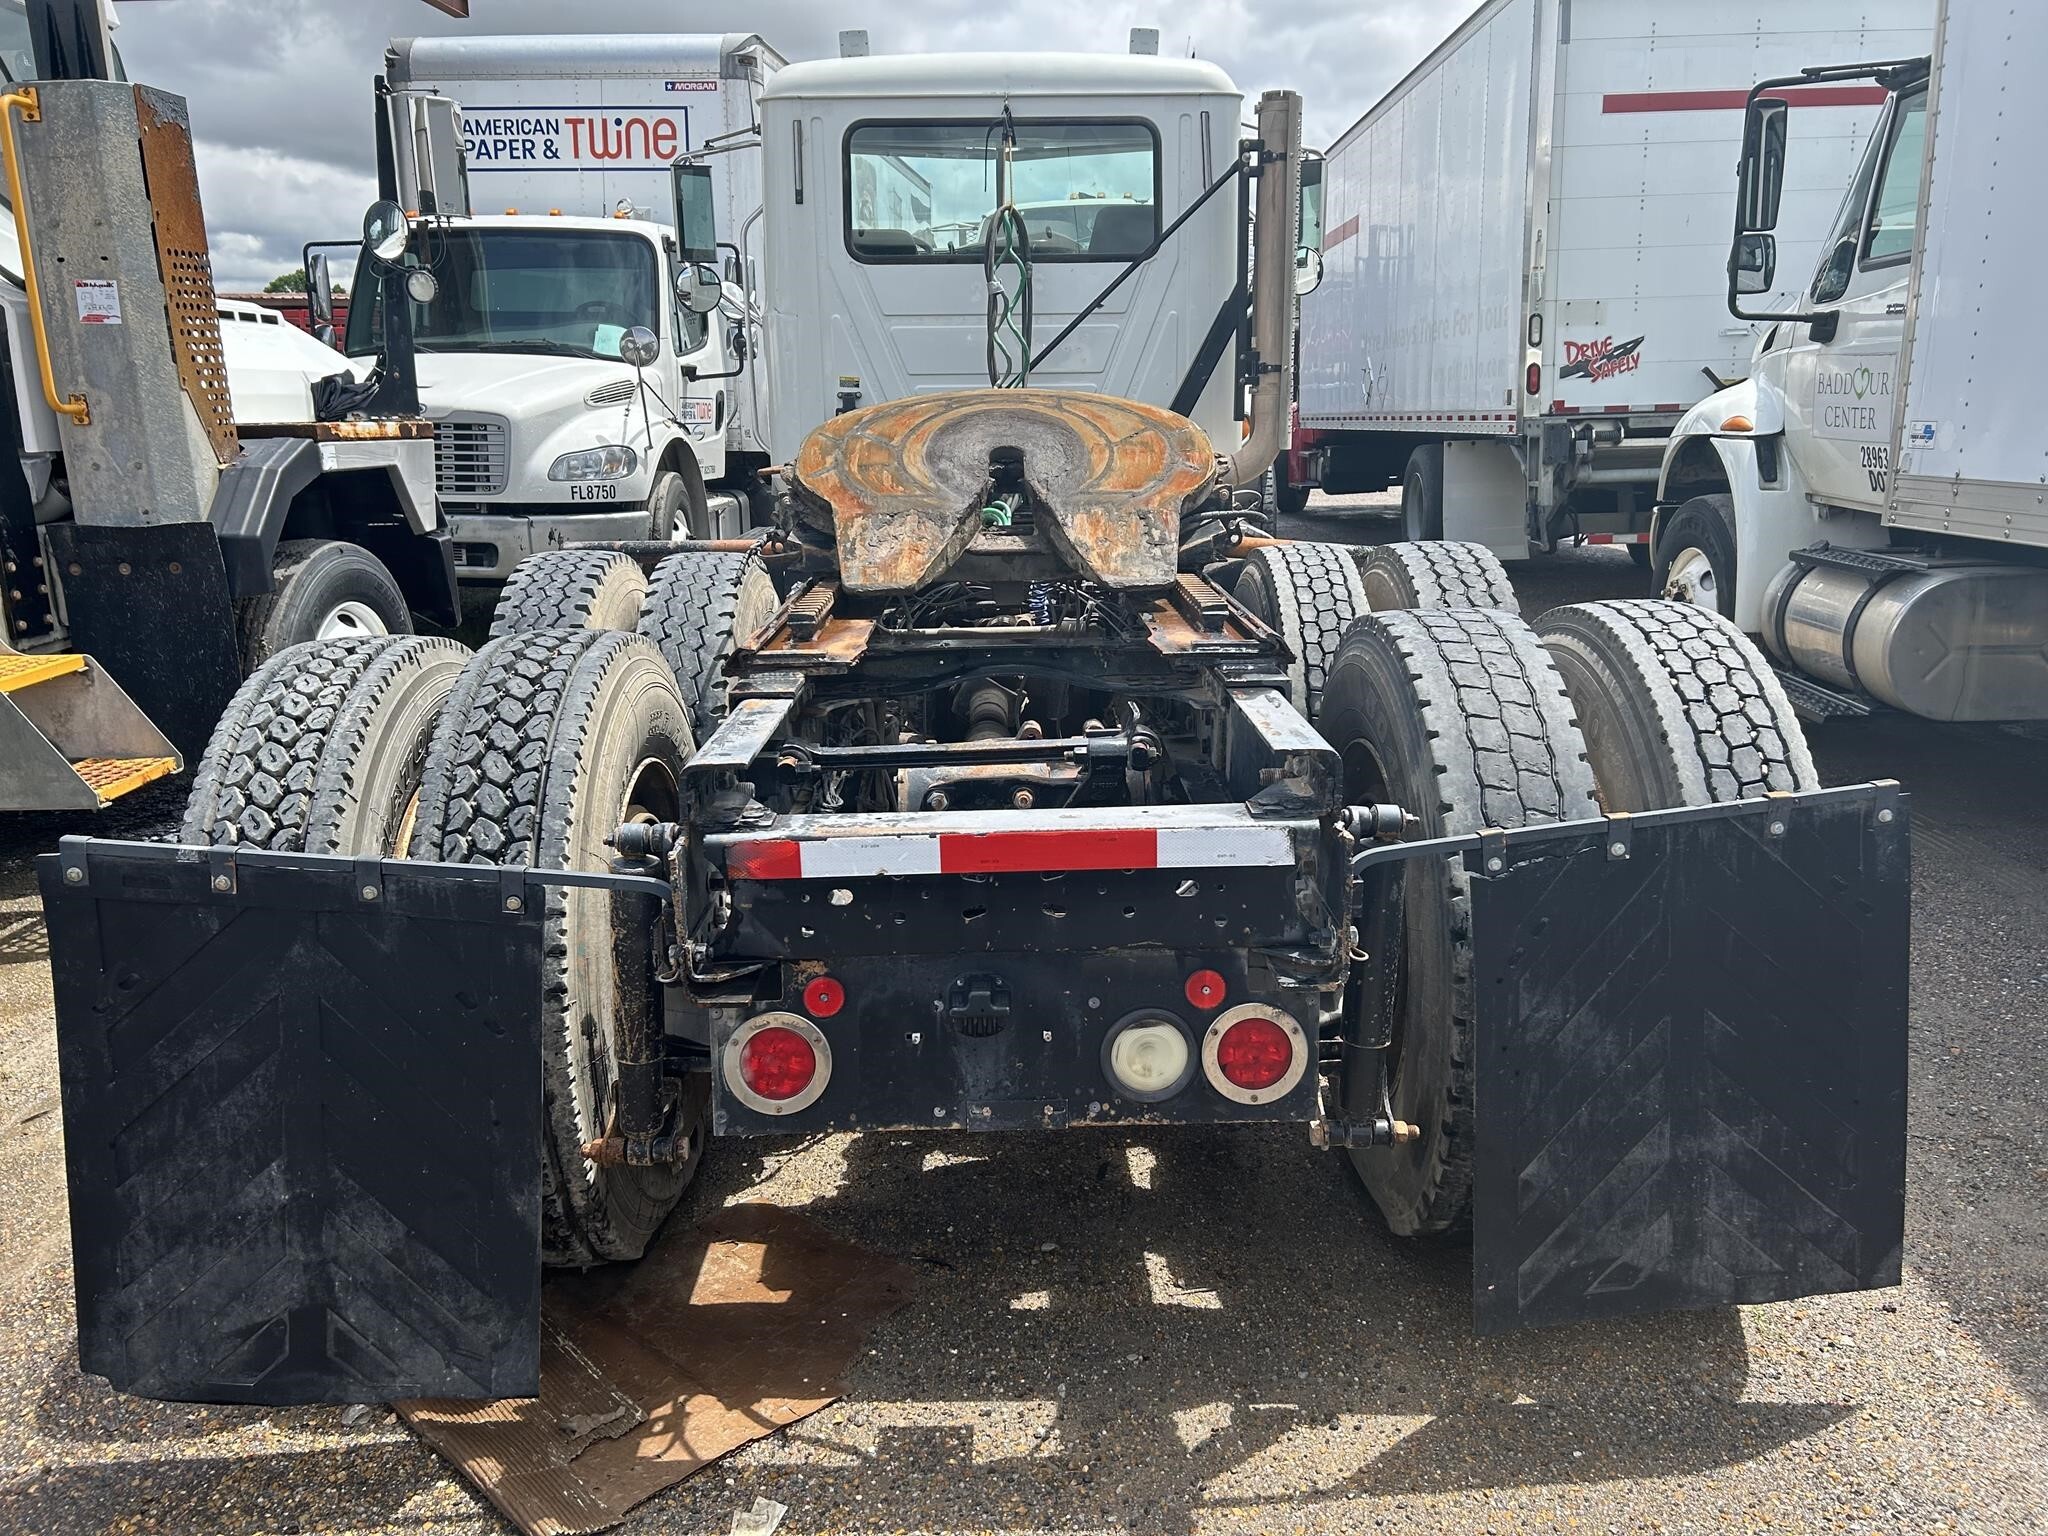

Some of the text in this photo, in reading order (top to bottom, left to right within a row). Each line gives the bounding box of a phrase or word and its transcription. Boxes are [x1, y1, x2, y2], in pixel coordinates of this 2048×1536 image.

[674, 82, 716, 91] MORGAN
[462, 118, 560, 136] AMERICAN
[464, 138, 561, 160] PAPER &
[1563, 335, 1614, 366] DRIVE
[1588, 351, 1641, 383] SAFELY
[1817, 364, 1890, 400] BADDOUR
[1824, 405, 1877, 430] CENTER
[1860, 445, 1889, 470] 28963
[570, 484, 616, 500] FL8750
